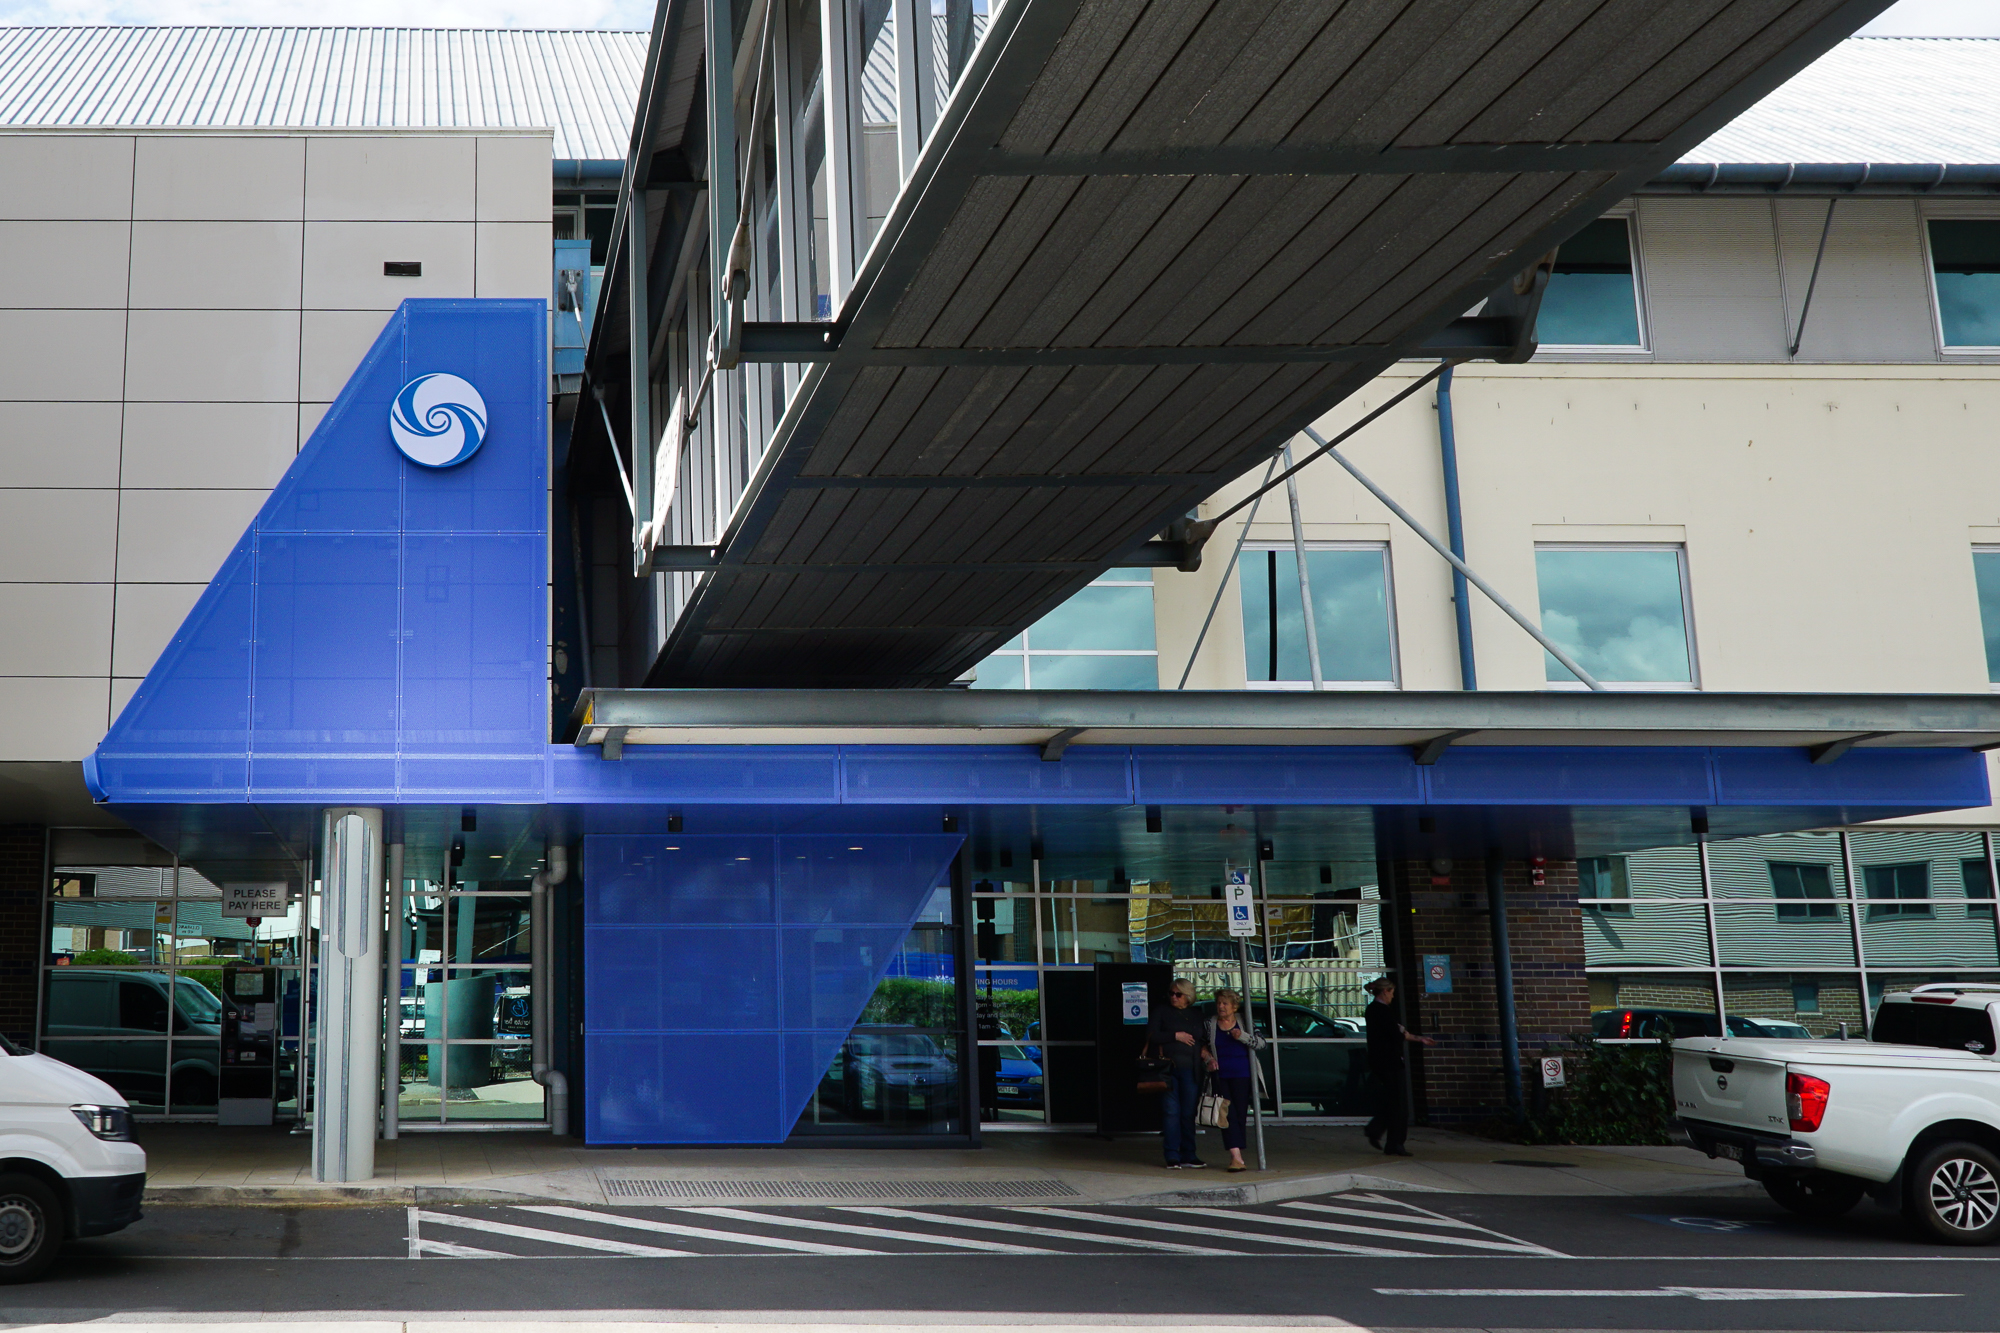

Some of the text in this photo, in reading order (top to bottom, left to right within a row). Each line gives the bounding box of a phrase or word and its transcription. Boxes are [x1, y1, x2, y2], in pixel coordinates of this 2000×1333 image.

[233, 889, 276, 898] PLEASE
[1234, 888, 1244, 900] P
[228, 901, 281, 910] PAY HERE
[992, 978, 1019, 986] HOURS
